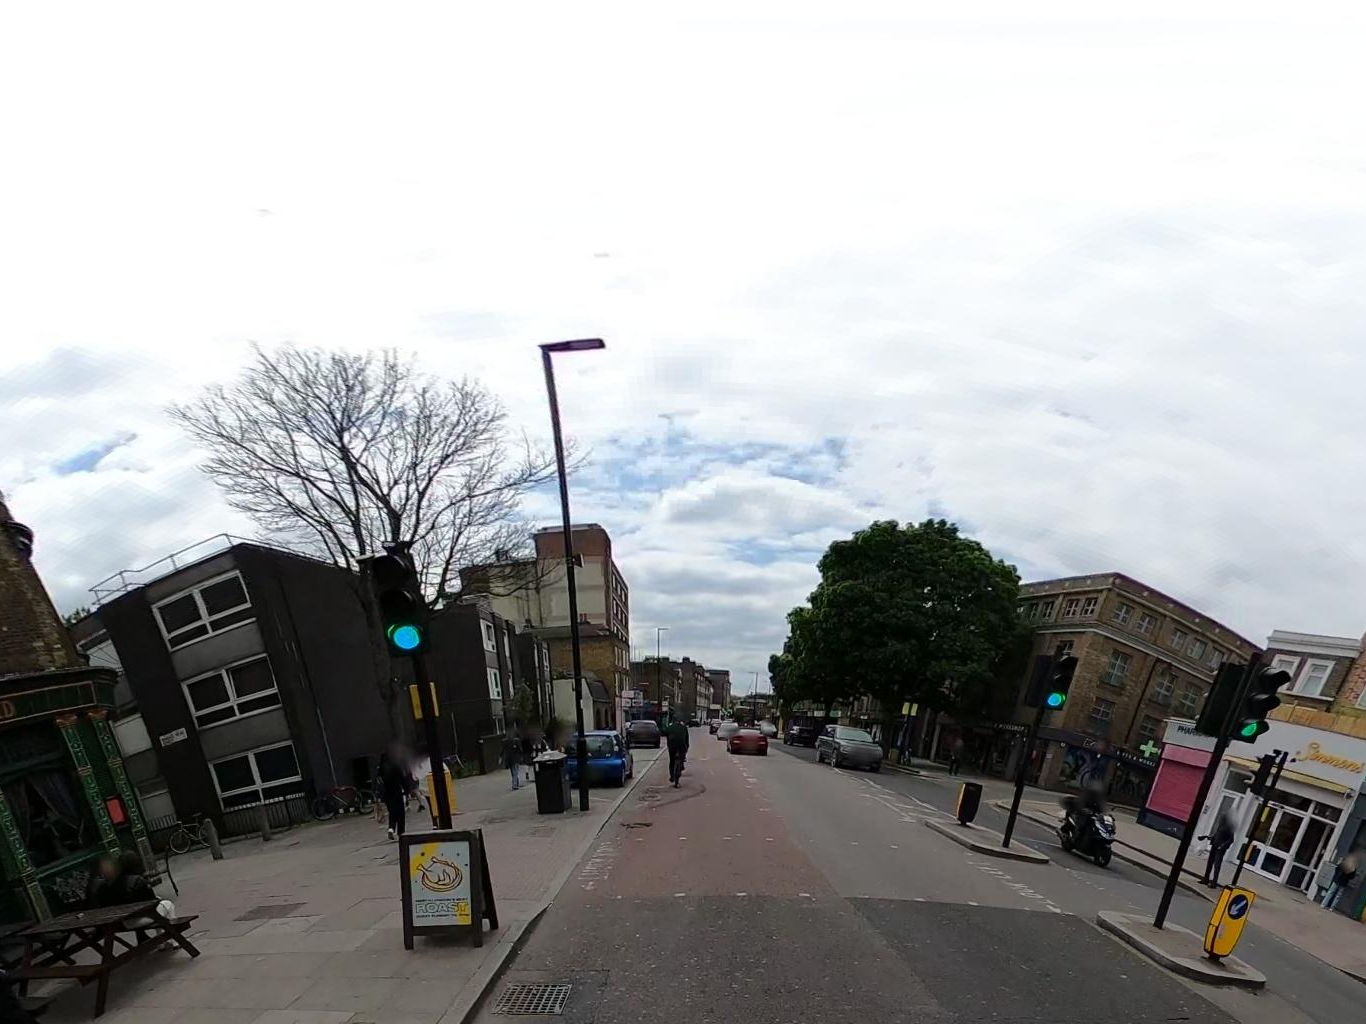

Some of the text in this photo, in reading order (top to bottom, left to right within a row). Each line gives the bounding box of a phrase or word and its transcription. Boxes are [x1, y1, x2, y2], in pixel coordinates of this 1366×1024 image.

[1177, 725, 1197, 736] PHAR
[1297, 742, 1365, 773] Simmons
[415, 901, 468, 914] ROAST
